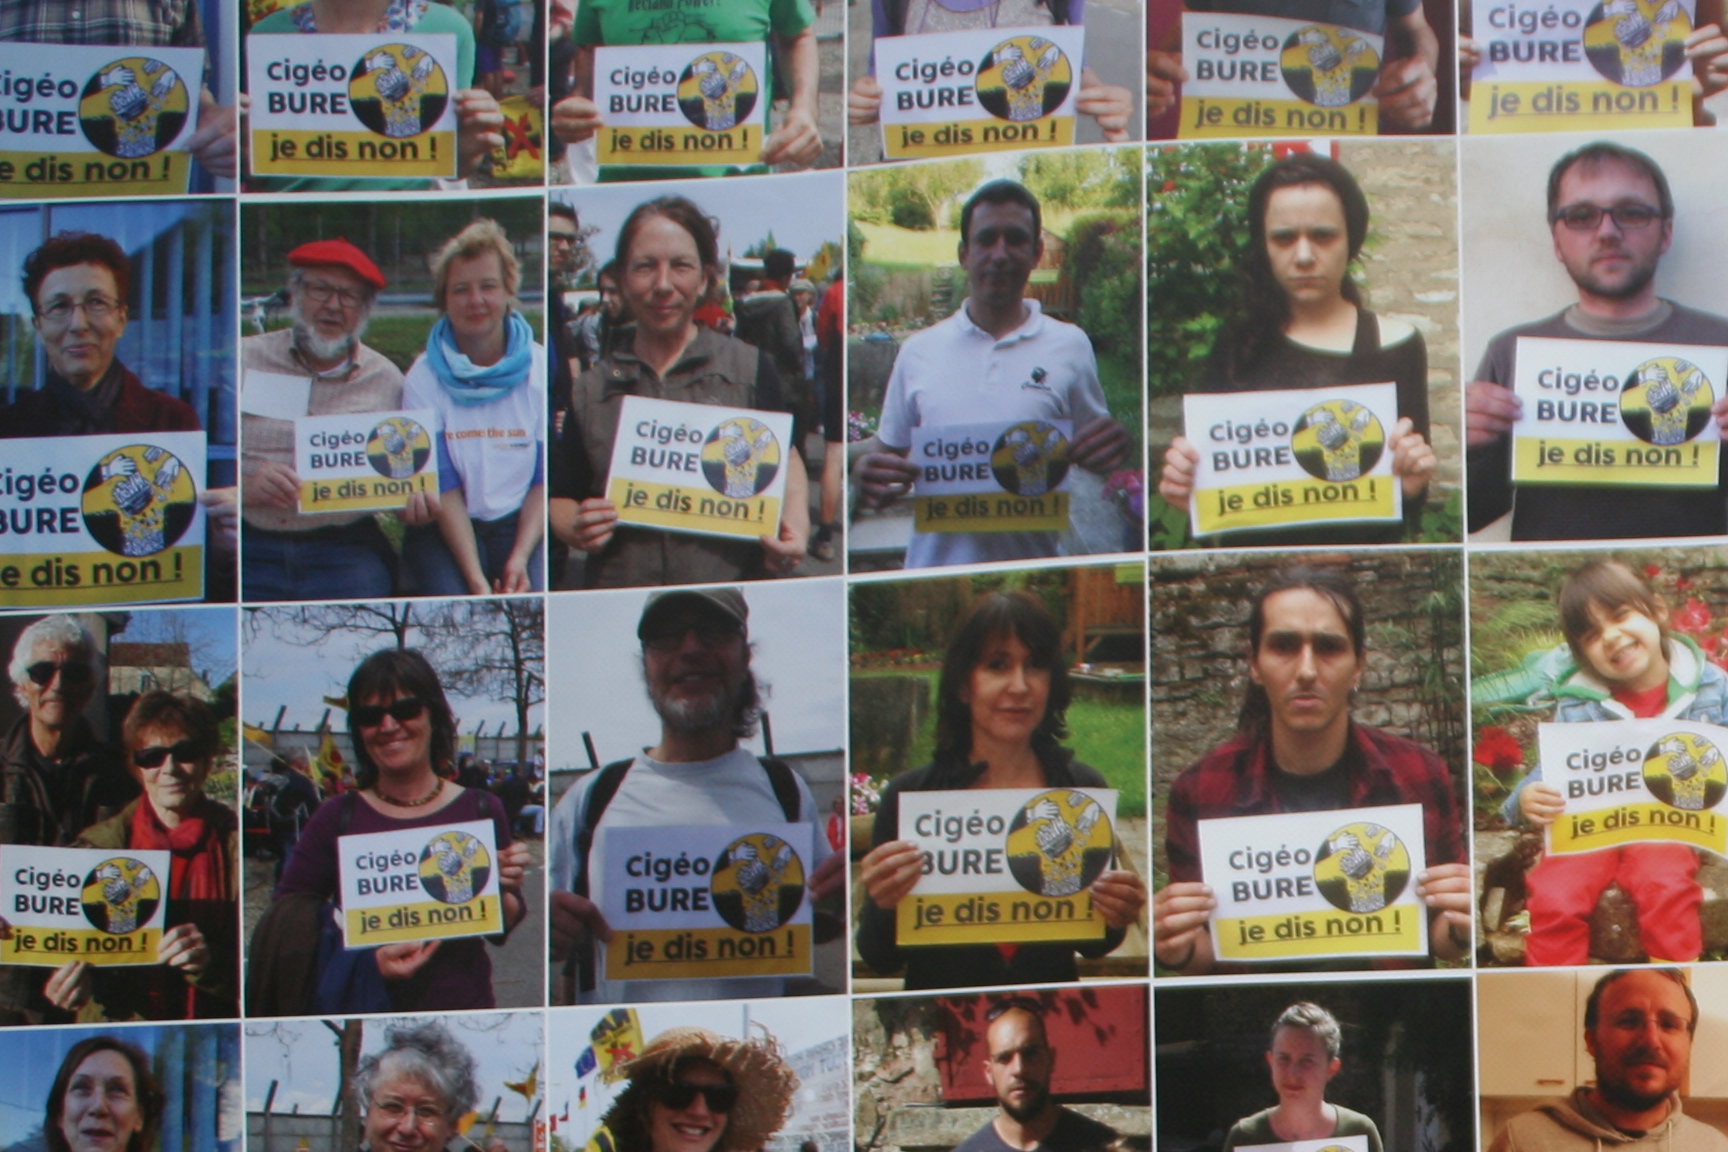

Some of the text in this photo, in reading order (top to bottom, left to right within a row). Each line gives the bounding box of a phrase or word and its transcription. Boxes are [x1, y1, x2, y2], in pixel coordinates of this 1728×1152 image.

[1197, 28, 1279, 55] Cigéo
[267, 59, 346, 86] Cigéo
[1197, 60, 1277, 82] BURE
[269, 92, 346, 114] BURE
[1195, 99, 1223, 129] je
[1232, 101, 1276, 128] dis
[1287, 109, 1346, 130] non
[270, 133, 297, 162] je
[306, 134, 348, 161] dis
[359, 142, 418, 161] non
[636, 420, 703, 445] Cigéo
[1210, 419, 1288, 444] Cigéo
[631, 447, 698, 472] BURE
[1213, 446, 1290, 472] BURE
[623, 483, 649, 509] je
[656, 489, 691, 514] dis
[700, 497, 749, 521] non
[1218, 491, 1243, 517] je
[1253, 485, 1294, 509] dis
[1304, 484, 1358, 504] non
[1566, 746, 1641, 772] Cigéo
[1568, 772, 1640, 798] BURE
[1571, 816, 1595, 839] je
[1604, 808, 1639, 828] dis
[1650, 810, 1700, 829] non
[356, 850, 416, 872] Cigéo
[358, 874, 418, 895] BURE
[361, 912, 381, 934] je
[388, 907, 421, 928] dis
[428, 906, 472, 924] non
